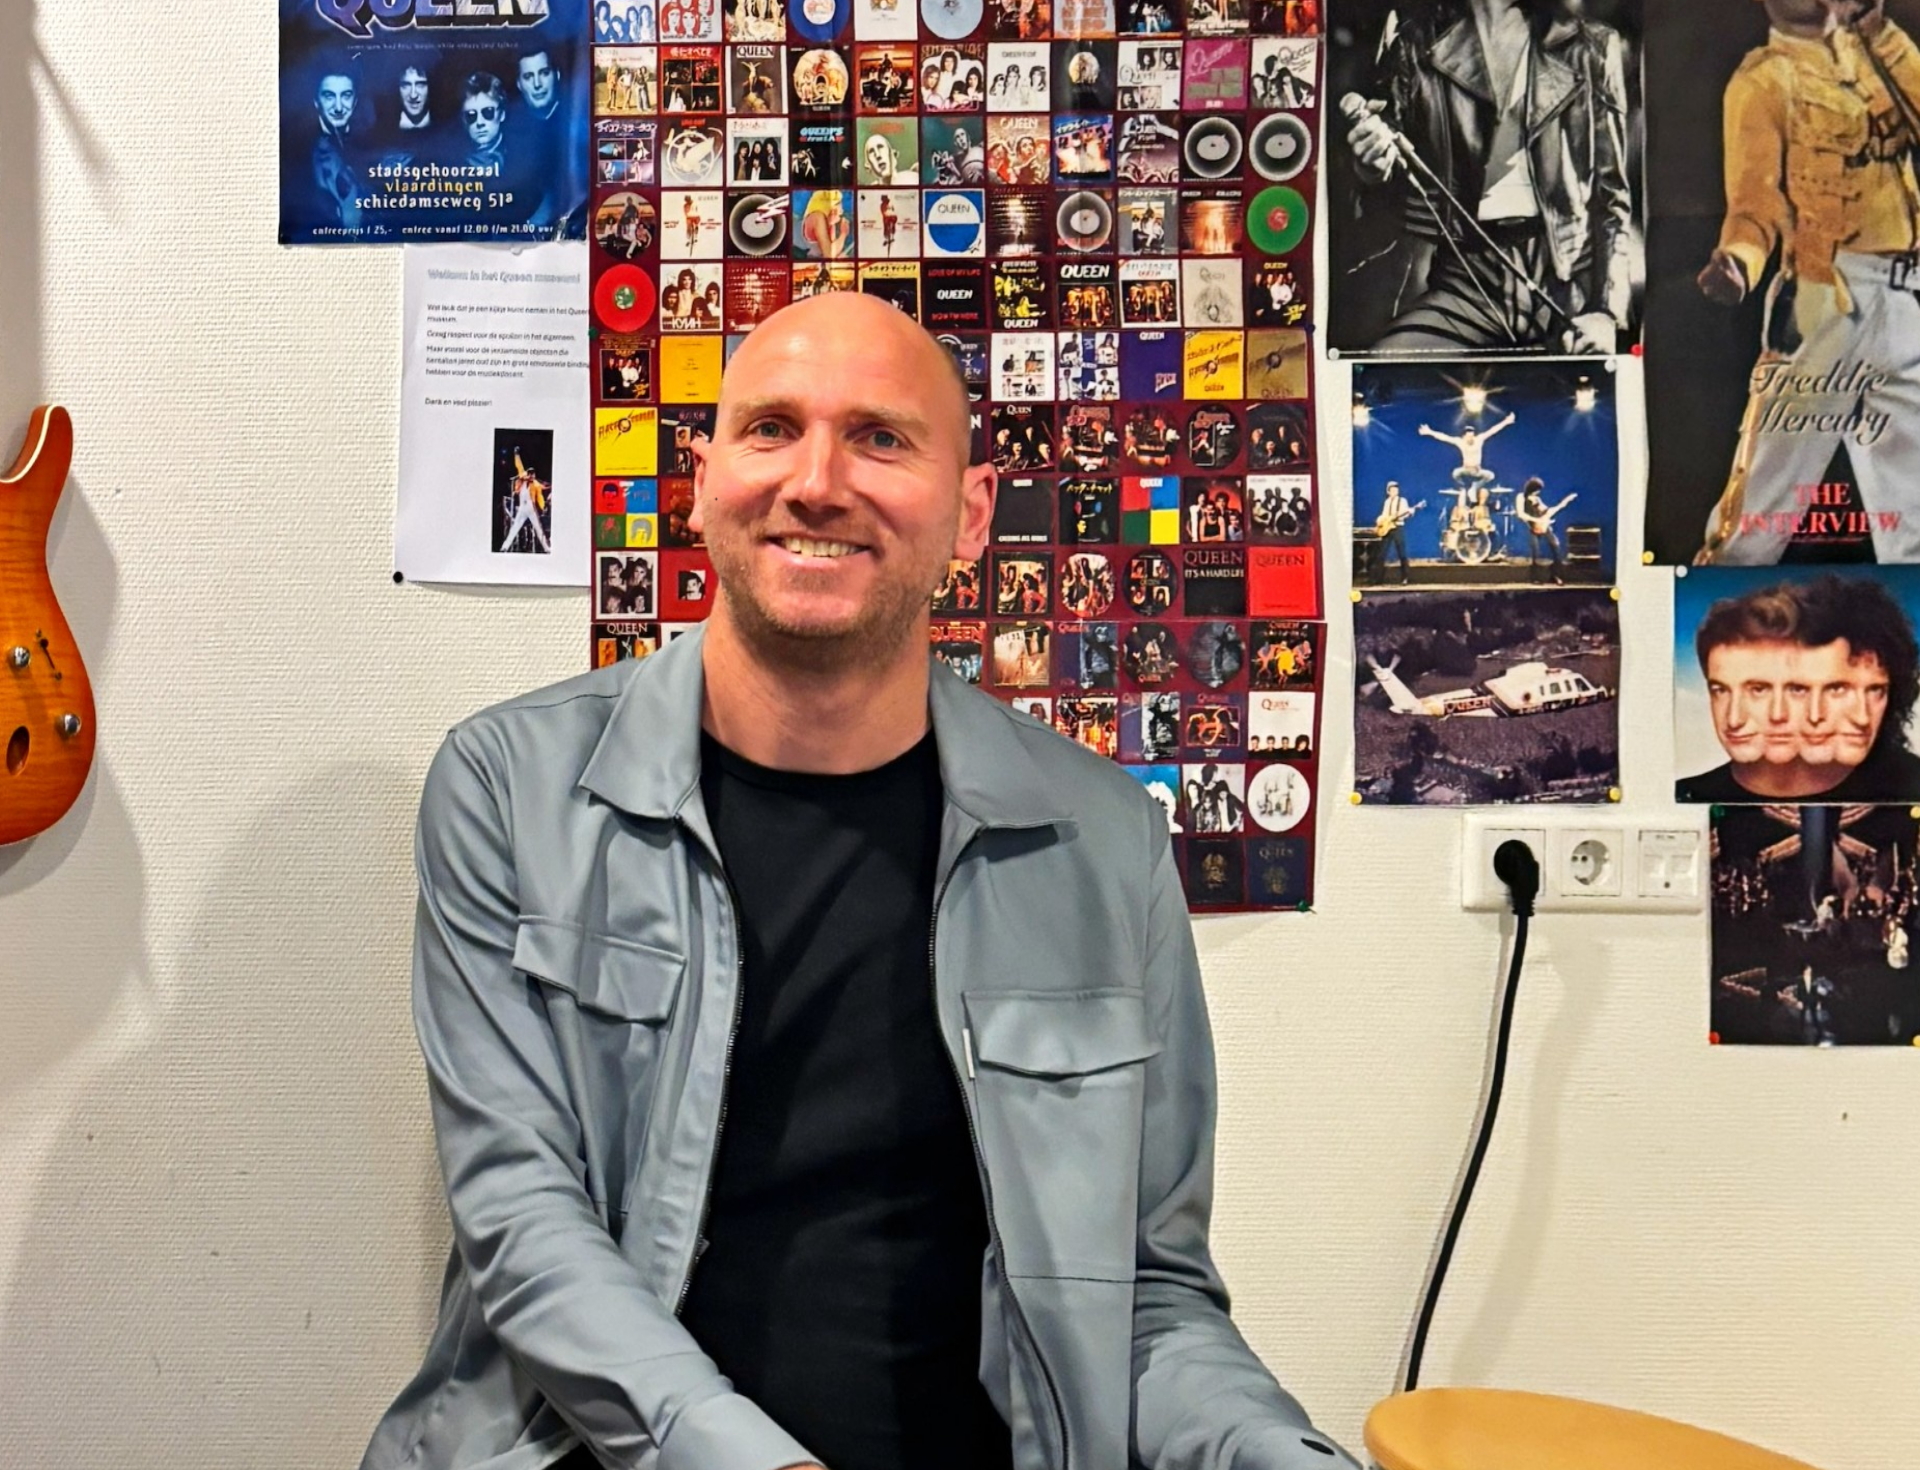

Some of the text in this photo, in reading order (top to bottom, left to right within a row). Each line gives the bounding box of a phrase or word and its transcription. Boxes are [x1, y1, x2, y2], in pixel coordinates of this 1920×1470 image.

[737, 46, 774, 57] QUEEN
[1000, 118, 1038, 129] QUEEN
[368, 163, 500, 180] stadsgehoorzaal
[385, 178, 484, 195] vlaardingen
[355, 194, 482, 211] schiedamseweg
[937, 204, 970, 214] QUEEN
[402, 225, 433, 234] entree
[435, 224, 460, 233] vanaf
[464, 224, 489, 233] 12.00
[510, 224, 535, 233] 21.00
[538, 225, 553, 233] uur
[1060, 264, 1110, 278] QUEEN
[937, 289, 973, 300] QUEEN
[1004, 319, 1038, 328] QUEEN
[1750, 359, 1887, 396] Freddie
[1758, 400, 1891, 445] Mercury
[1794, 483, 1851, 505] THE
[1738, 510, 1902, 535] INTERVIEW
[1185, 550, 1243, 565] QUEEN
[1256, 554, 1305, 567] QUEEN
[1185, 569, 1199, 579] IT'S
[1200, 569, 1206, 578] A
[1206, 568, 1226, 578] HARD
[607, 623, 648, 634] QUEEN
[930, 626, 984, 642] QUEEN
